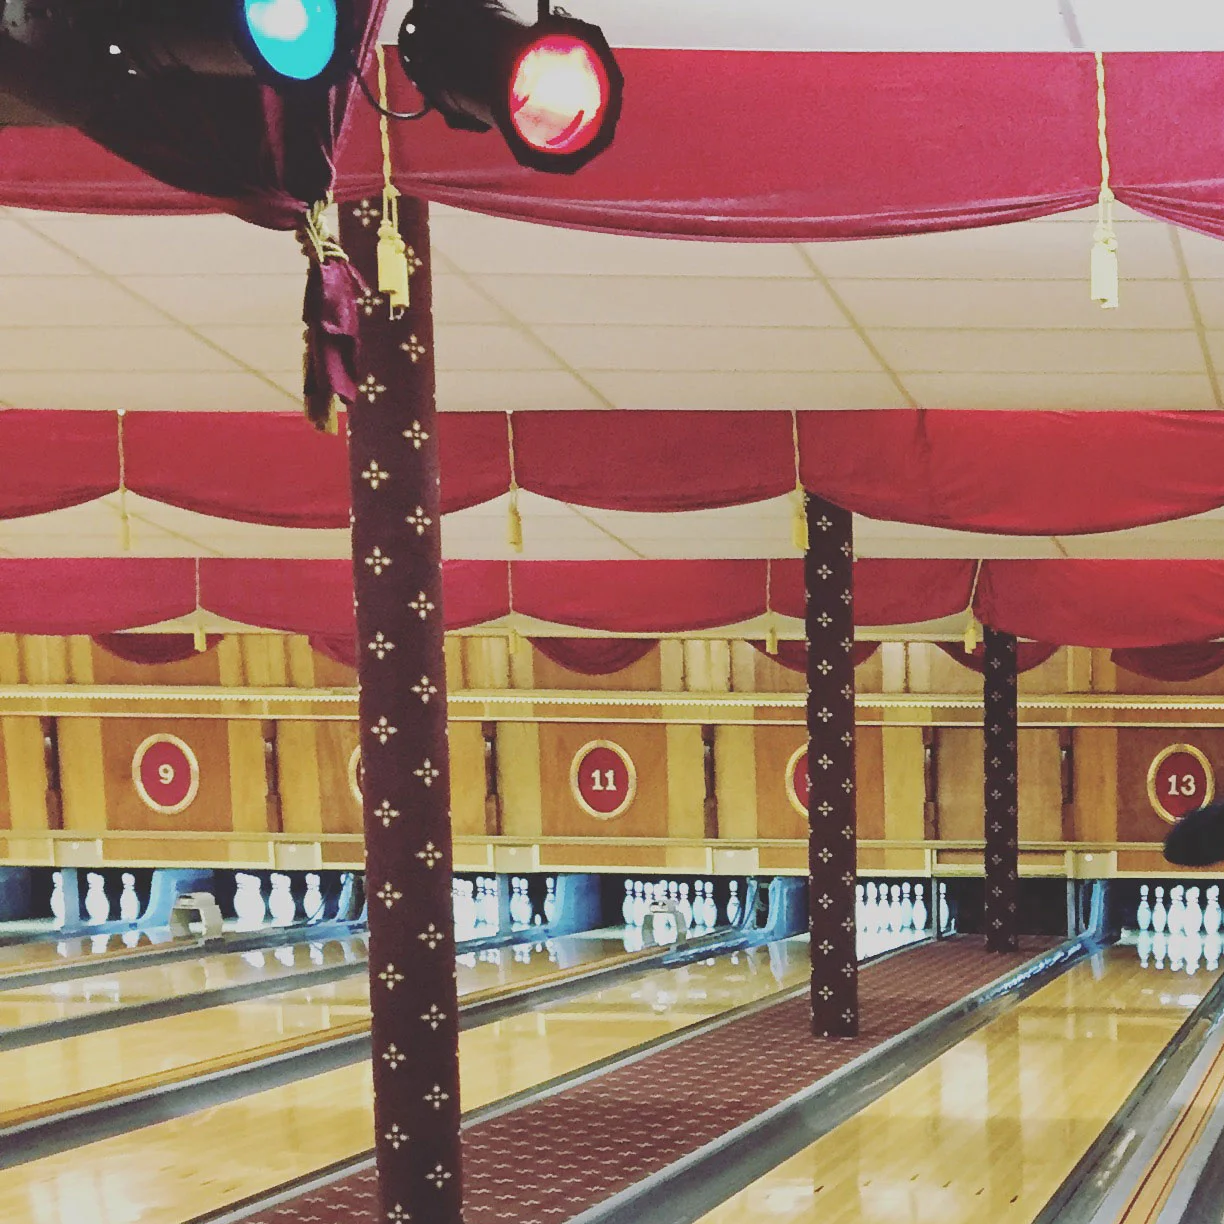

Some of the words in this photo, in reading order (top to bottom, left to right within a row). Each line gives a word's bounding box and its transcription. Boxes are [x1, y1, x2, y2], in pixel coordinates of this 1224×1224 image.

[158, 763, 175, 785] 9
[591, 769, 617, 791] 11
[1167, 774, 1196, 796] 13
